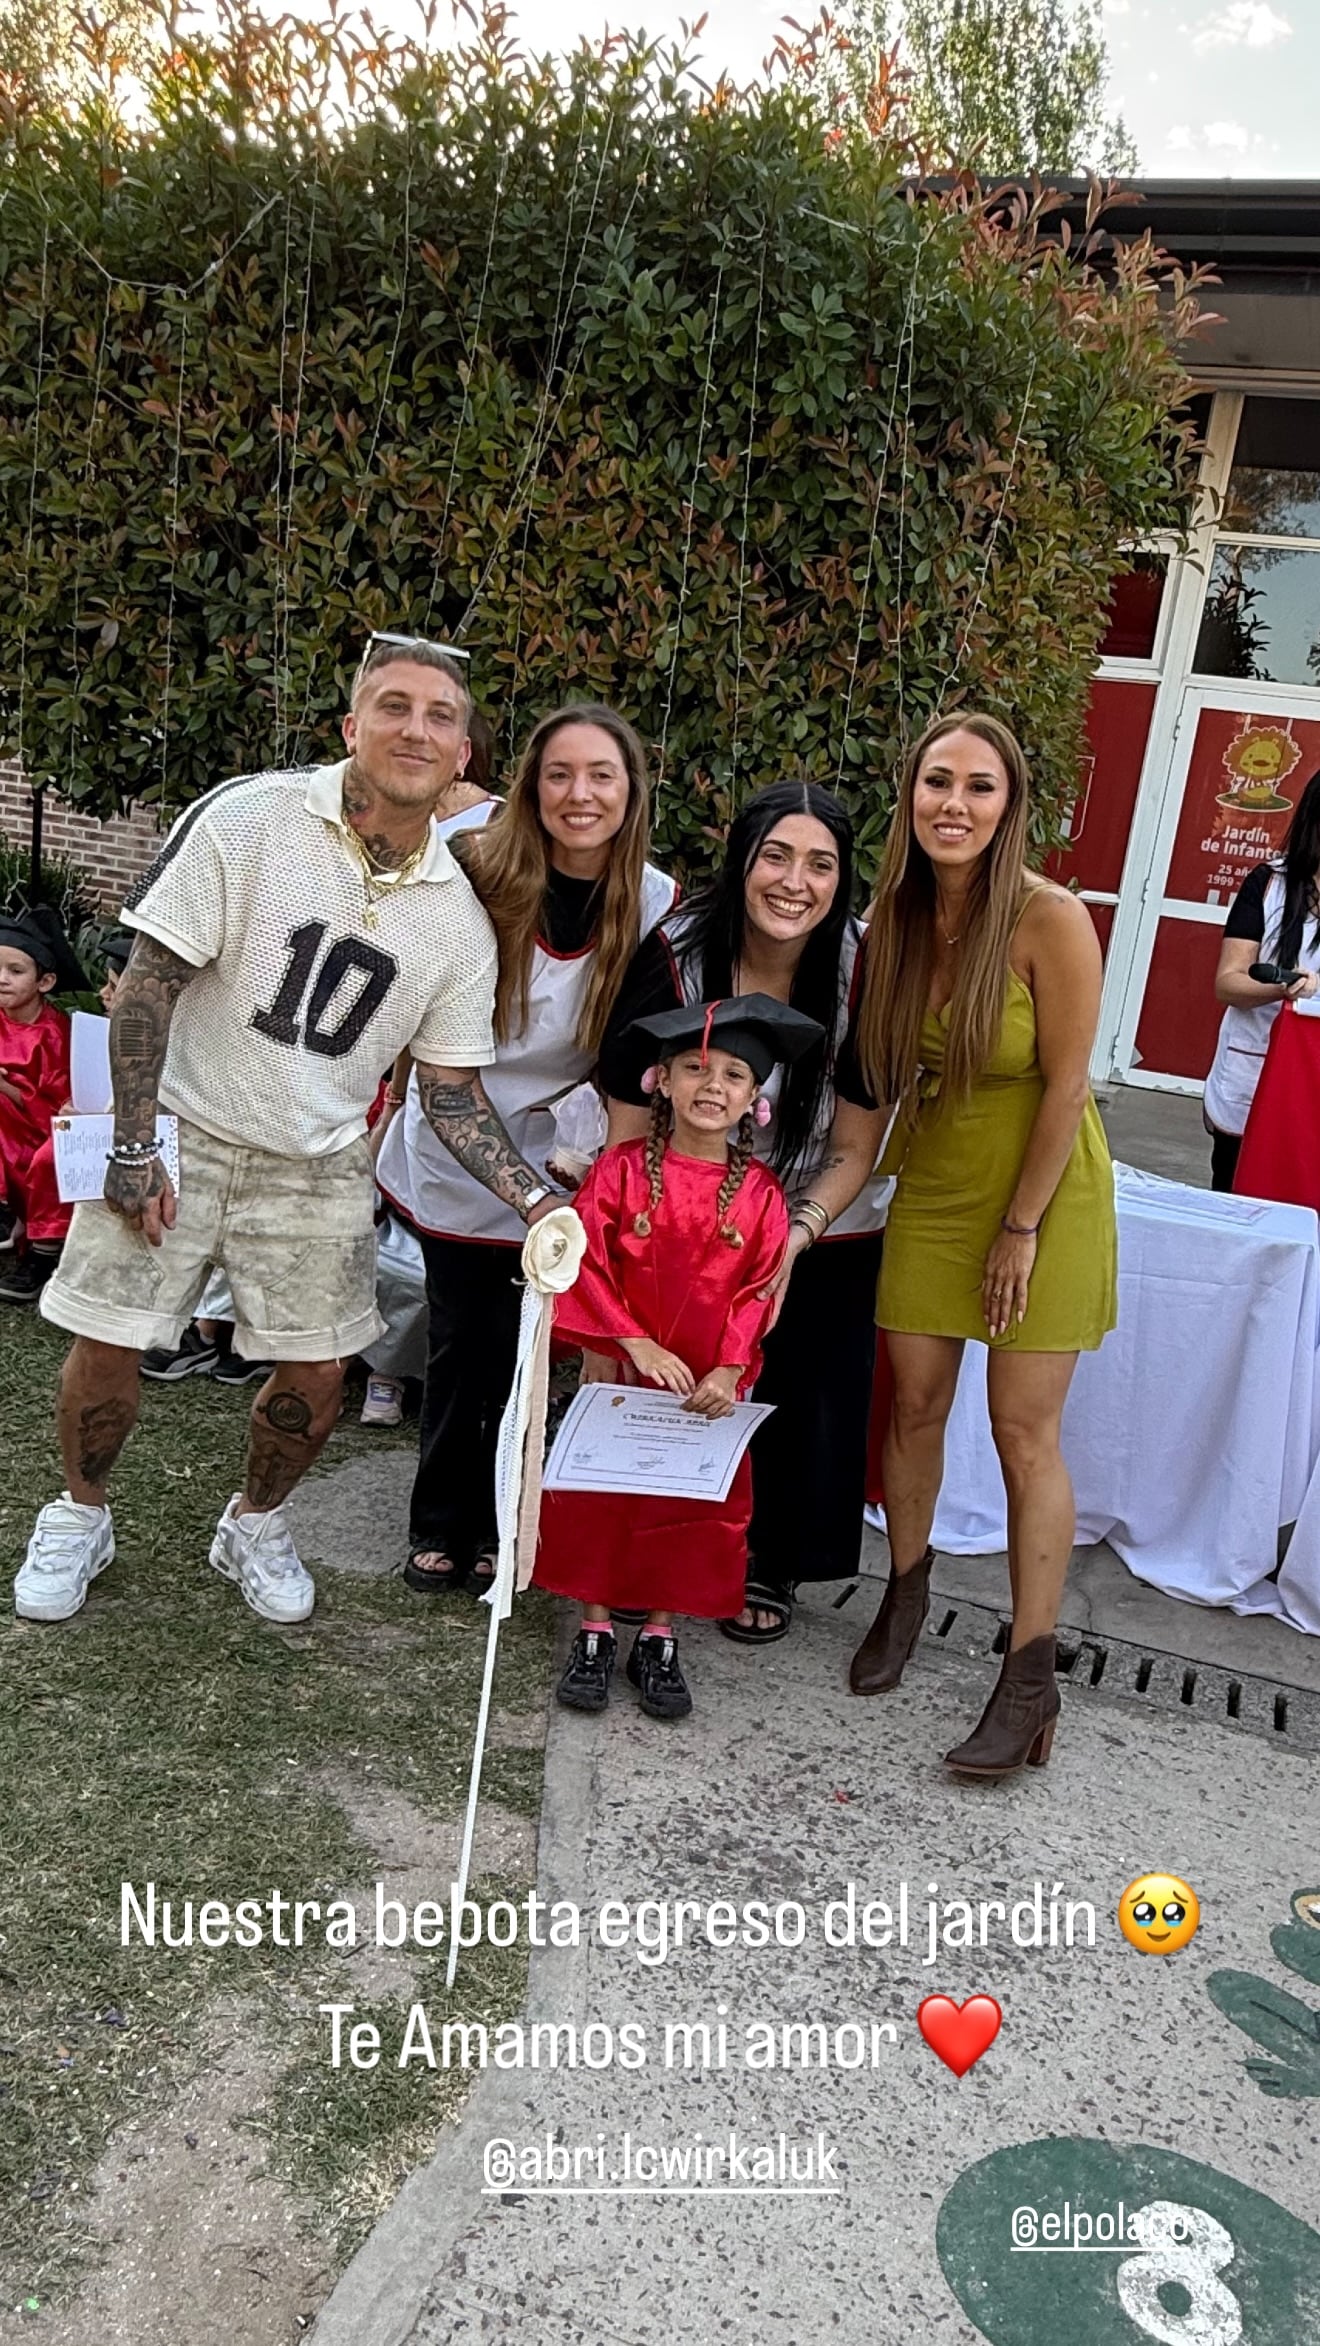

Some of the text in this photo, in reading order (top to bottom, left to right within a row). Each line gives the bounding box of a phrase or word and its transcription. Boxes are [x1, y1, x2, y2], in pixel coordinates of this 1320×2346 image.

[1222, 825, 1270, 844] Jardín
[1201, 837, 1220, 852] de
[1218, 864, 1232, 875] 25
[1206, 874, 1235, 886] 1999
[248, 918, 400, 1060] 10
[1117, 2201, 1243, 2346] 8
